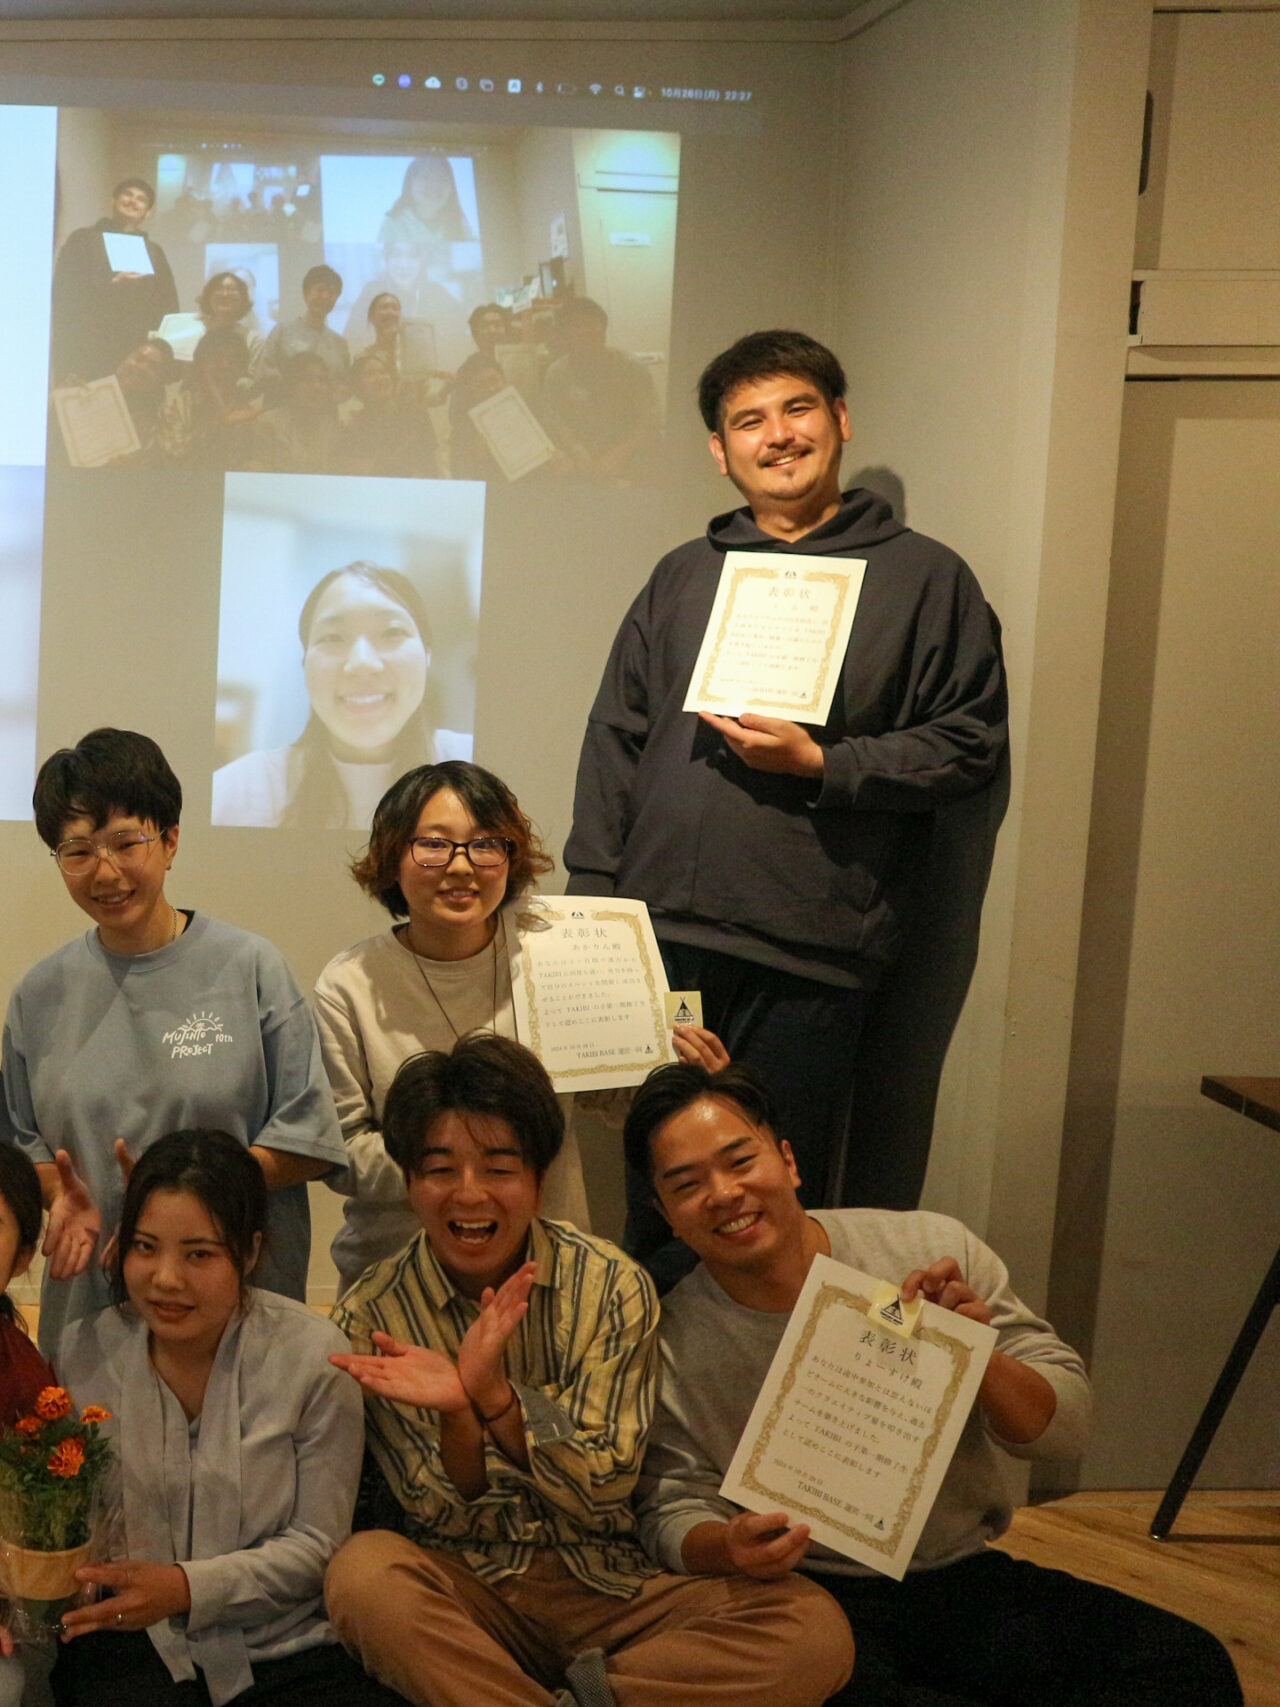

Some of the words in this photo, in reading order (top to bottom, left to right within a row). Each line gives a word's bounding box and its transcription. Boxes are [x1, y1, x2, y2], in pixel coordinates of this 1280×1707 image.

[561, 928, 608, 938] 表彰状
[859, 1329, 920, 1367] 表彰状
[852, 1350, 924, 1390] りょーすけ殿
[813, 1424, 842, 1443] TAKIBI
[795, 1479, 823, 1499] TAKIBI
[821, 1491, 843, 1508] BASE
